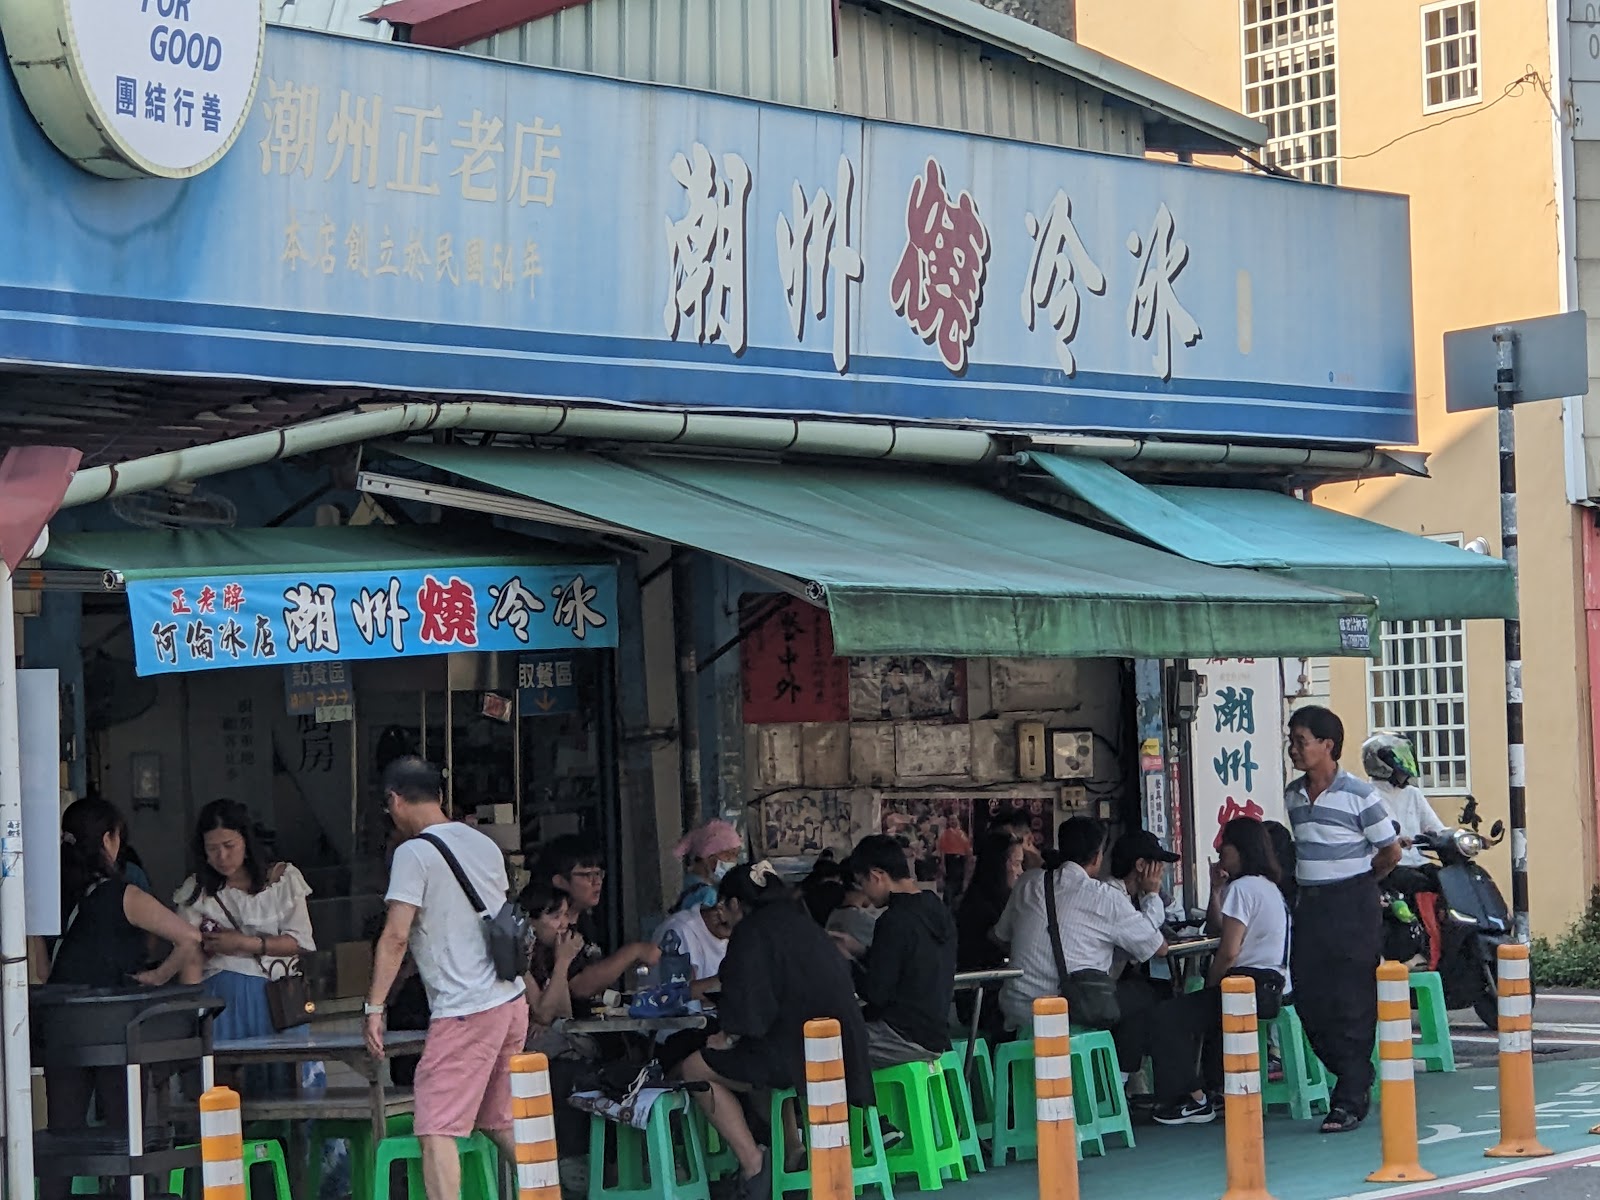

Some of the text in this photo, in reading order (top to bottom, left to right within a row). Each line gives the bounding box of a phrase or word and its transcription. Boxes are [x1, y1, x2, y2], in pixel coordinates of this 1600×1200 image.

[150, 25, 222, 72] GOOD
[115, 75, 222, 133] 團結行善
[259, 78, 563, 208] 潮州正老店
[281, 214, 544, 299] 本店創立於民國54年
[664, 142, 1204, 382] 潮州燒冷冰
[170, 582, 247, 616] 正老牌
[282, 575, 607, 654] 潮州燒冷冰
[518, 660, 573, 688] 取餐區
